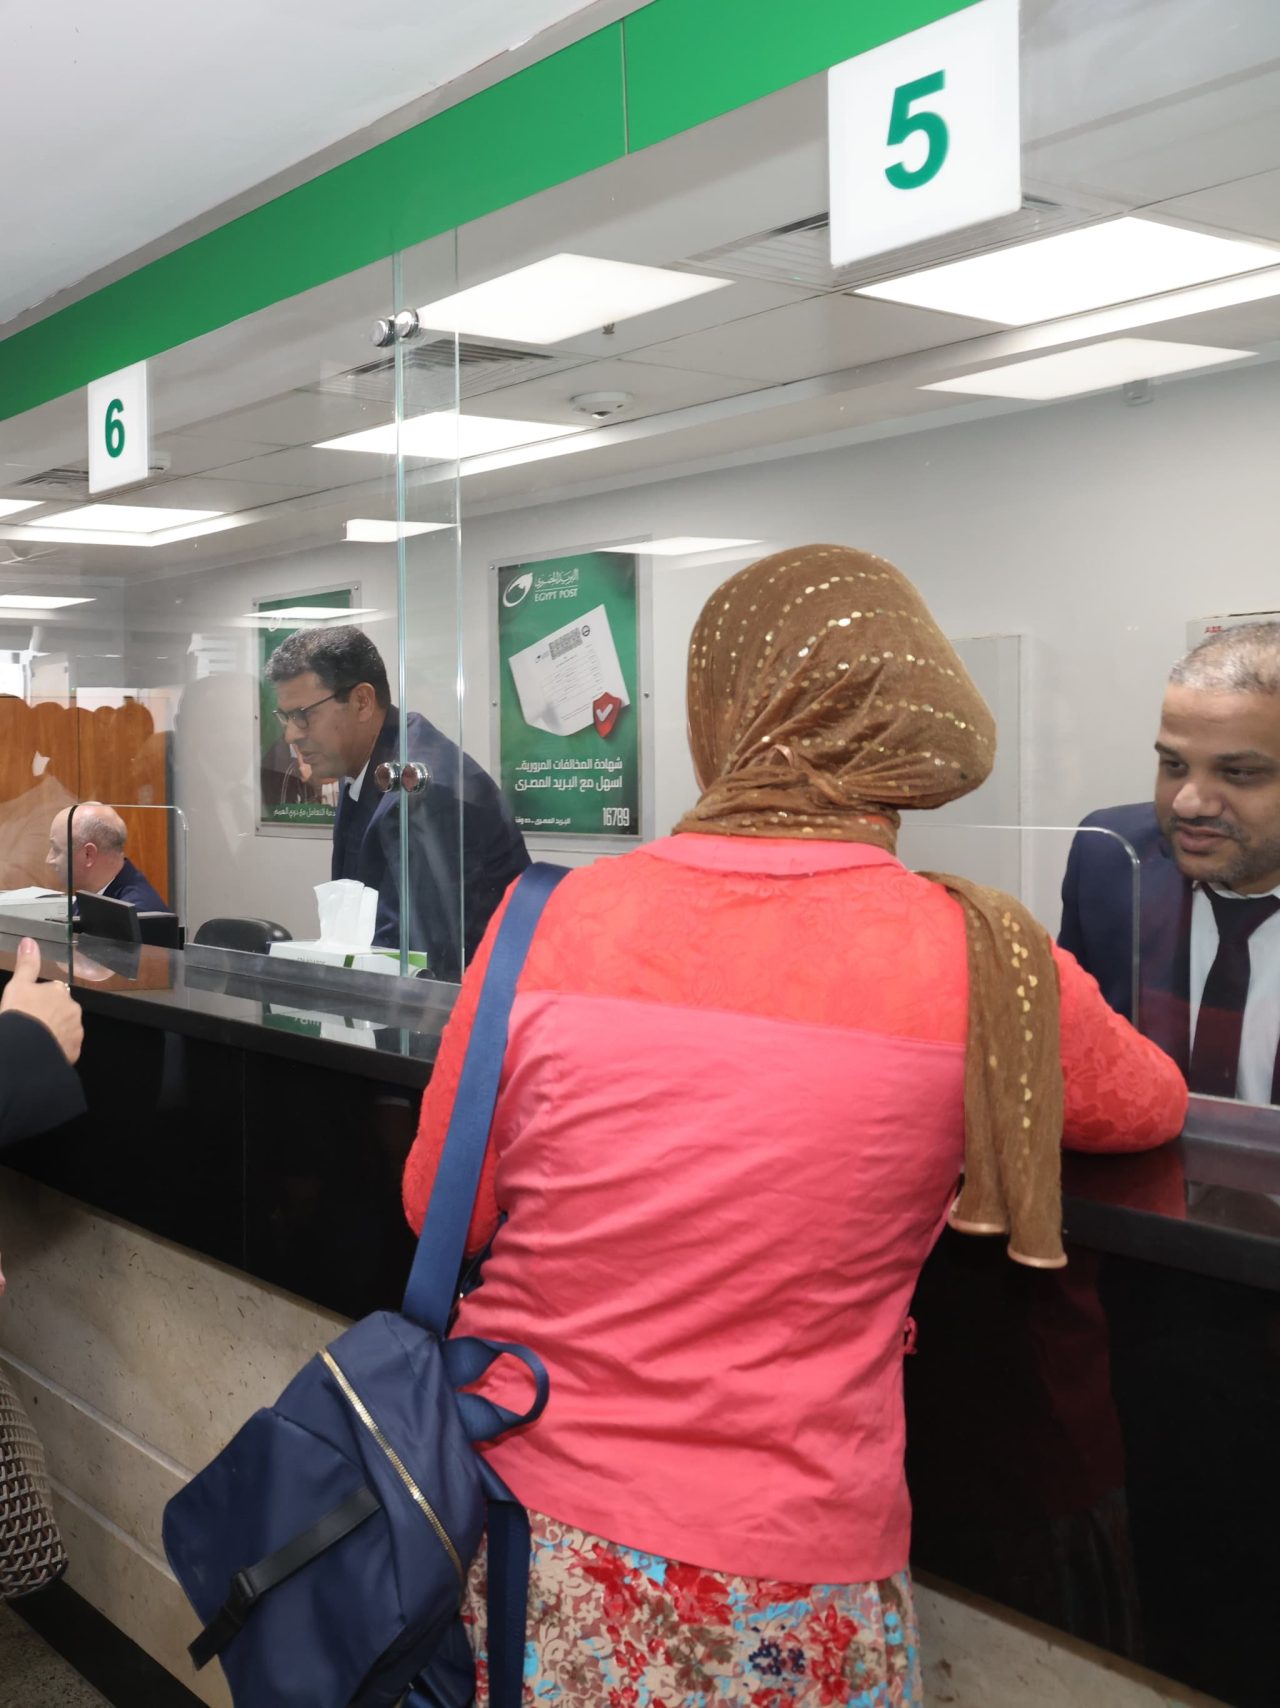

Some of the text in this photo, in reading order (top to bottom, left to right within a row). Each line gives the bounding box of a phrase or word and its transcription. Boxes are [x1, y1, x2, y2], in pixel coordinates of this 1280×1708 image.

[885, 69, 950, 190] 5
[104, 398, 125, 458] 6
[534, 588, 578, 602] EGYPT POST
[552, 759, 593, 770] المخالفات
[594, 757, 623, 773] شهادة
[553, 776, 577, 791] البريد
[579, 778, 594, 792] مع
[603, 807, 630, 826] 16789
